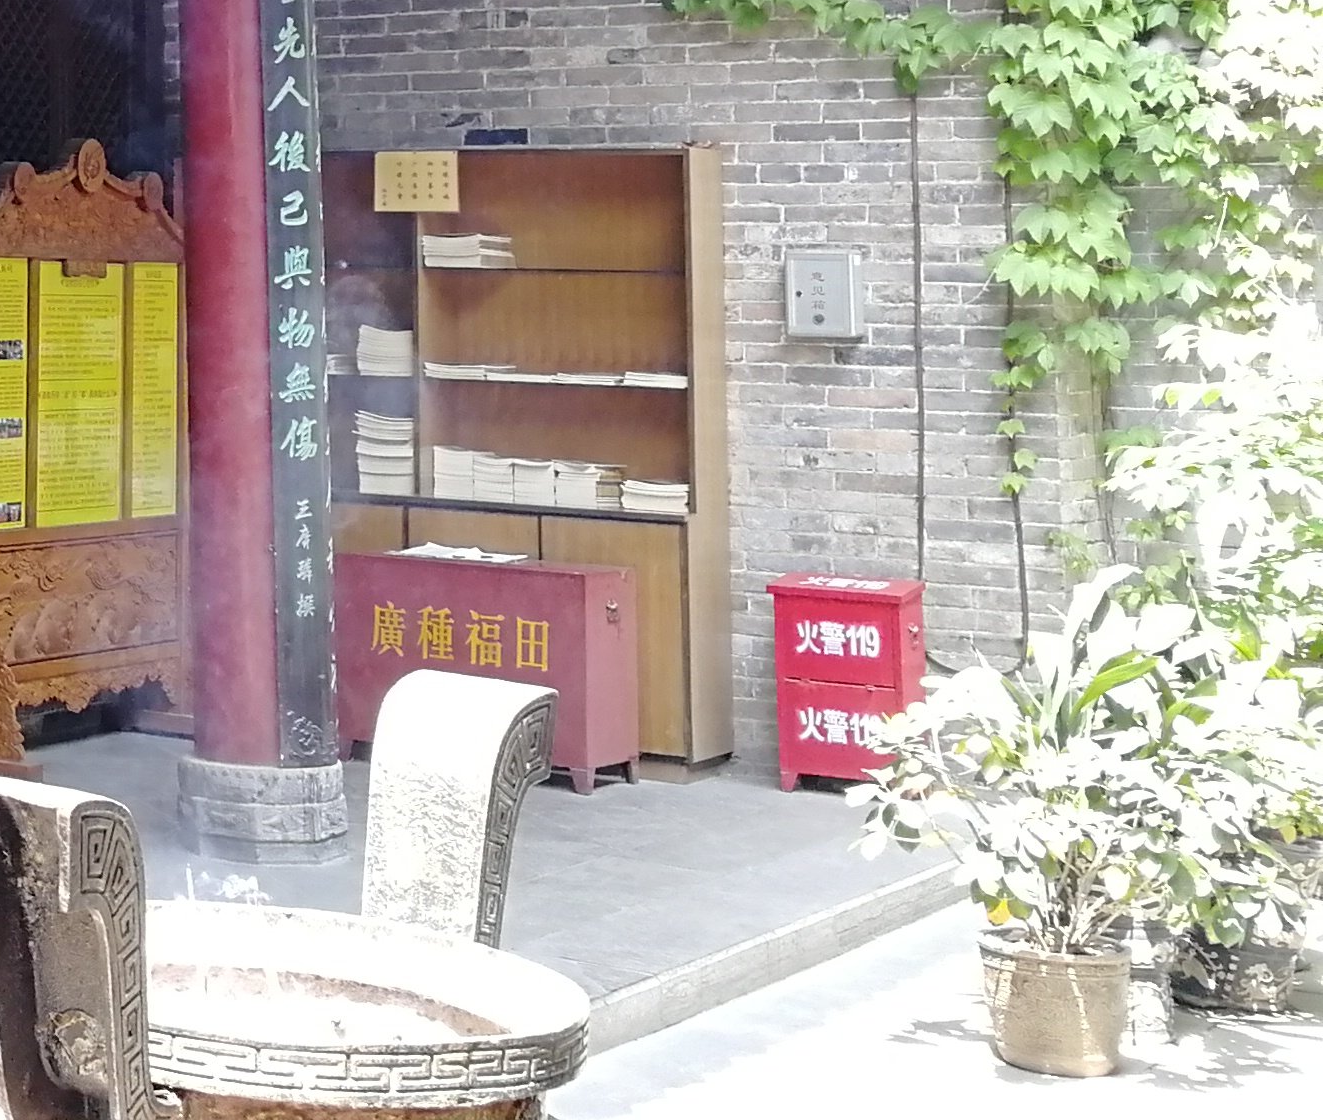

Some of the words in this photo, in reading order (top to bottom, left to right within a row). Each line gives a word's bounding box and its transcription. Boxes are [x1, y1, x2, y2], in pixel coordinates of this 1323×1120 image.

[799, 575, 891, 590] 火警119
[370, 600, 550, 672] 廣種福田
[795, 619, 881, 658] 火警119
